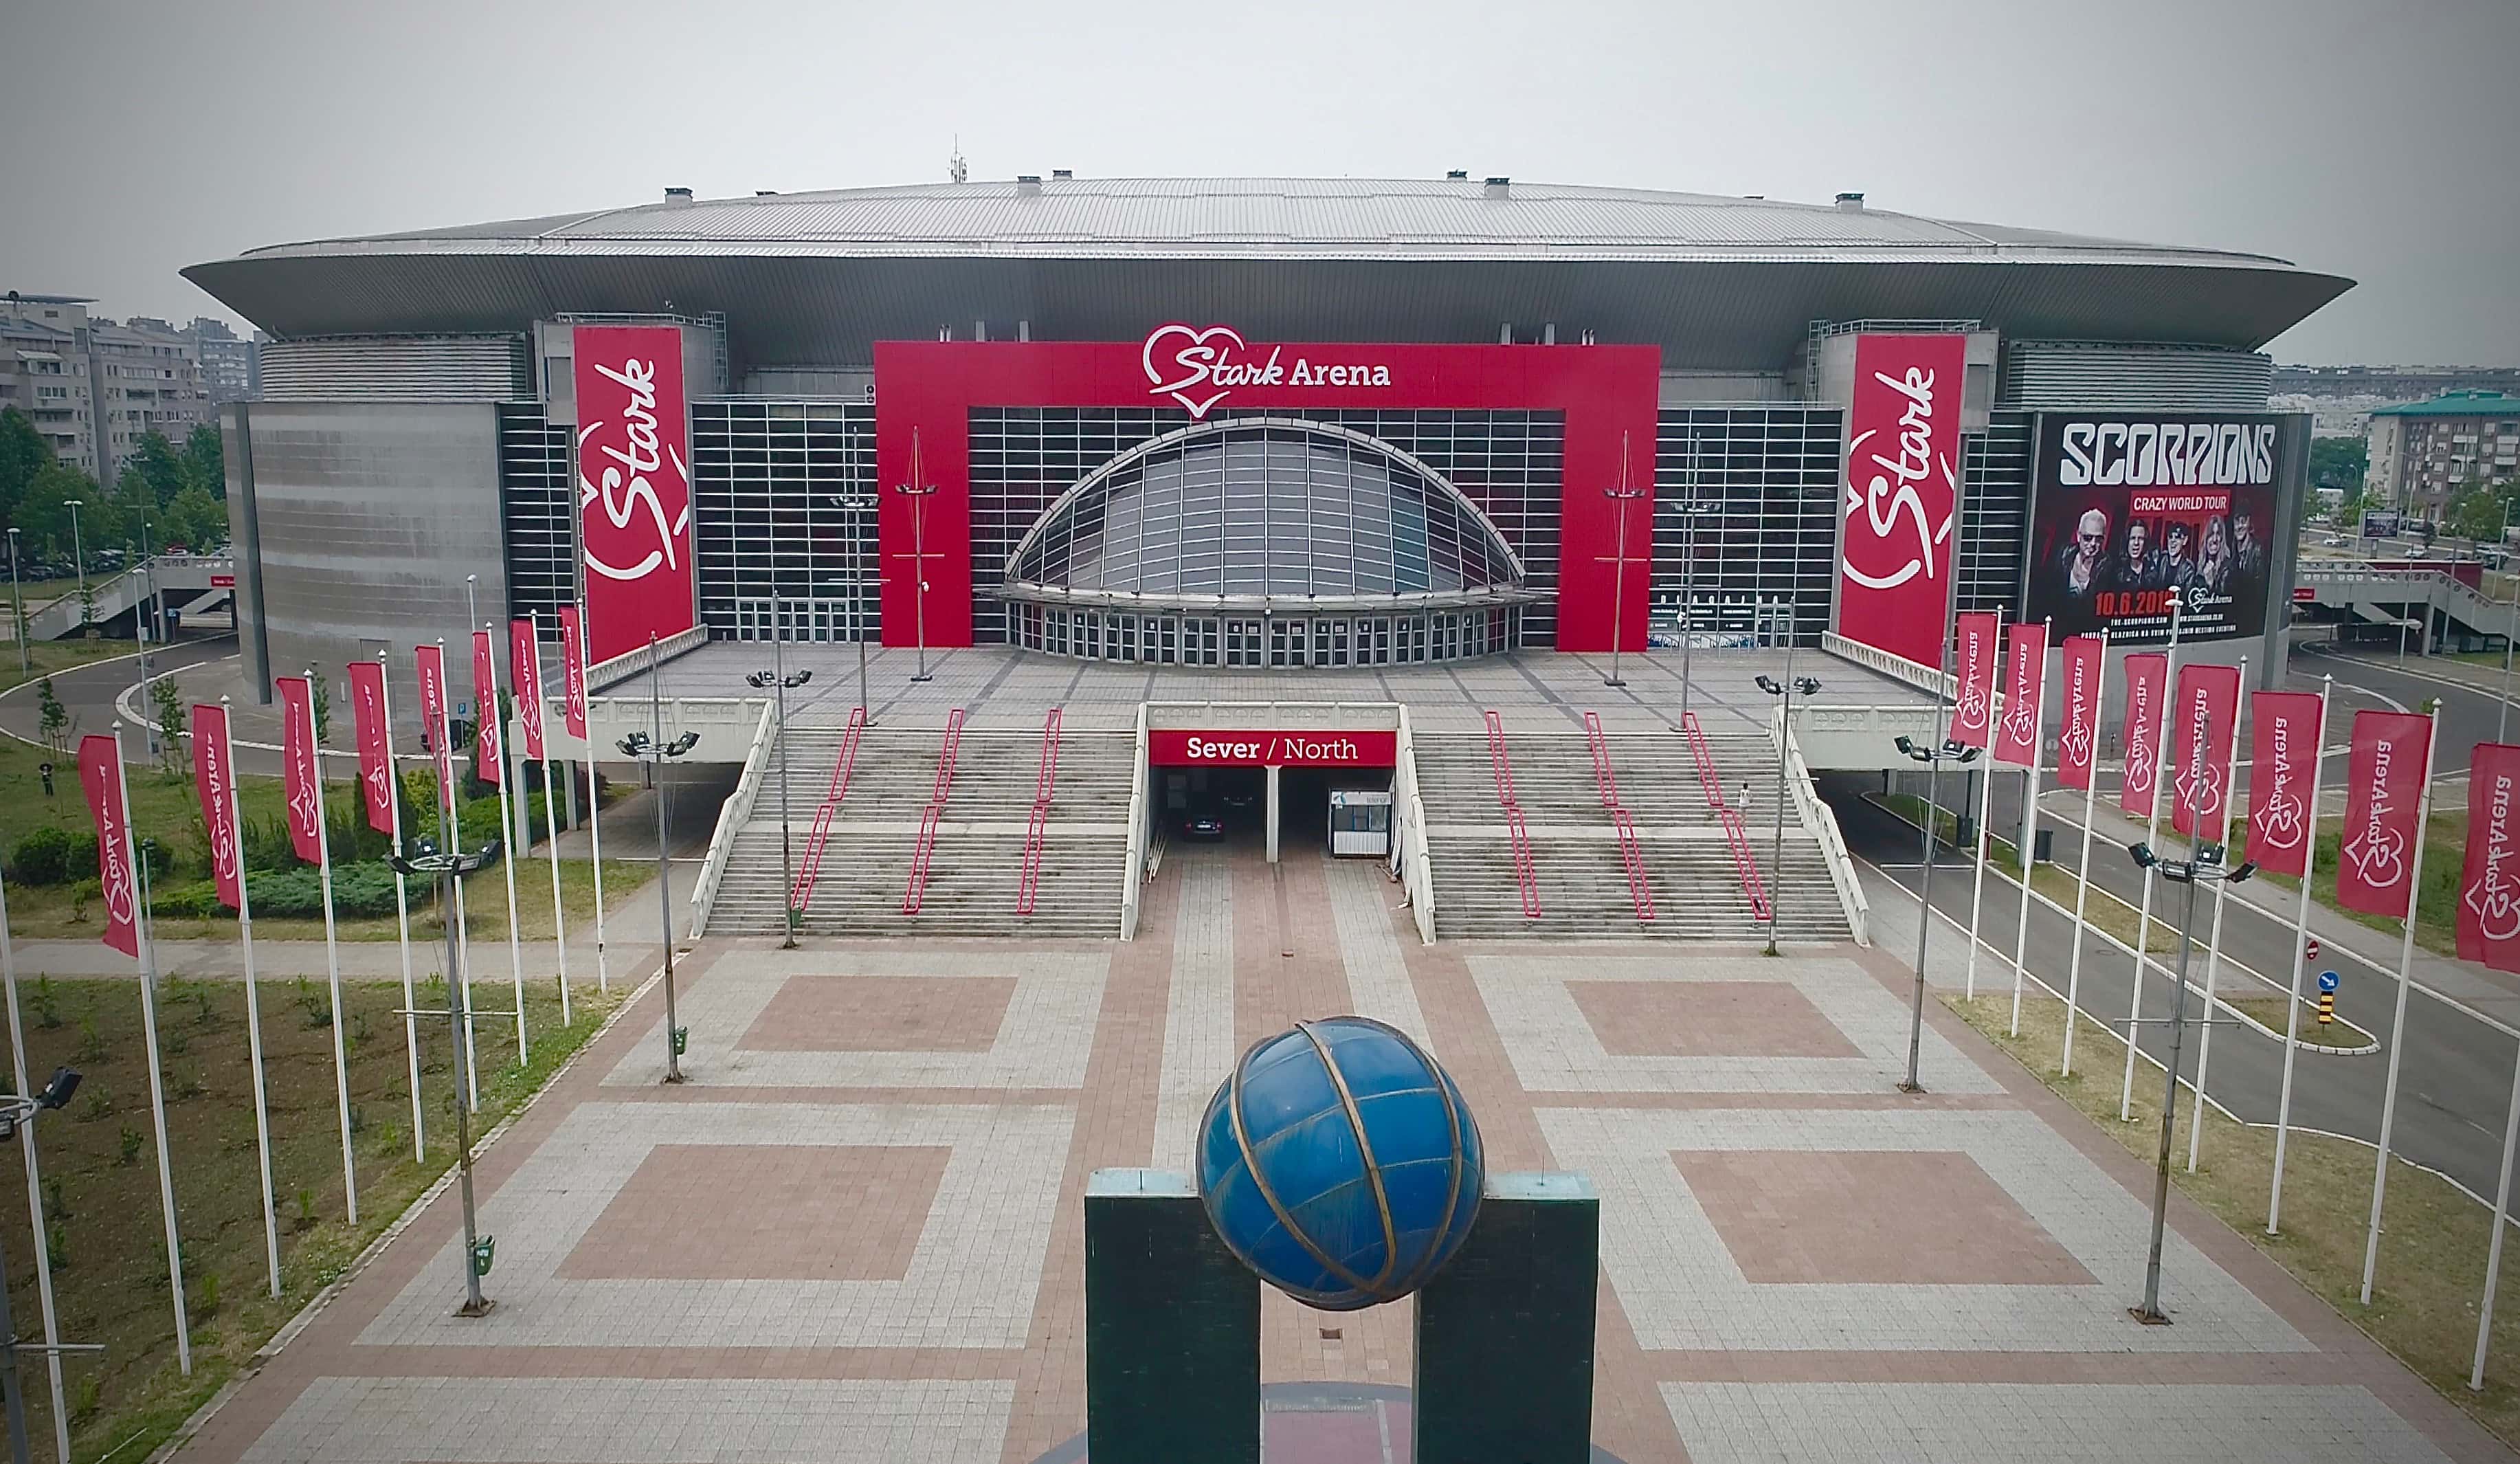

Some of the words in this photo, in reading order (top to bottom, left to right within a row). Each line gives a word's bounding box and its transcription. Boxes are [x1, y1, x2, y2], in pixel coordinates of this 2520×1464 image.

[1150, 345, 1283, 394] Stark
[1289, 358, 1391, 386] Arena
[594, 358, 676, 570] Stark
[1868, 366, 1934, 578] Stark
[2060, 423, 2276, 485] SCORPIONS
[2134, 497, 2167, 511] CRAZY
[2169, 496, 2203, 511] WORLD
[2204, 496, 2227, 510] TOUR
[1187, 737, 1260, 759] Sever
[1267, 737, 1277, 760] /
[1284, 737, 1359, 759] North
